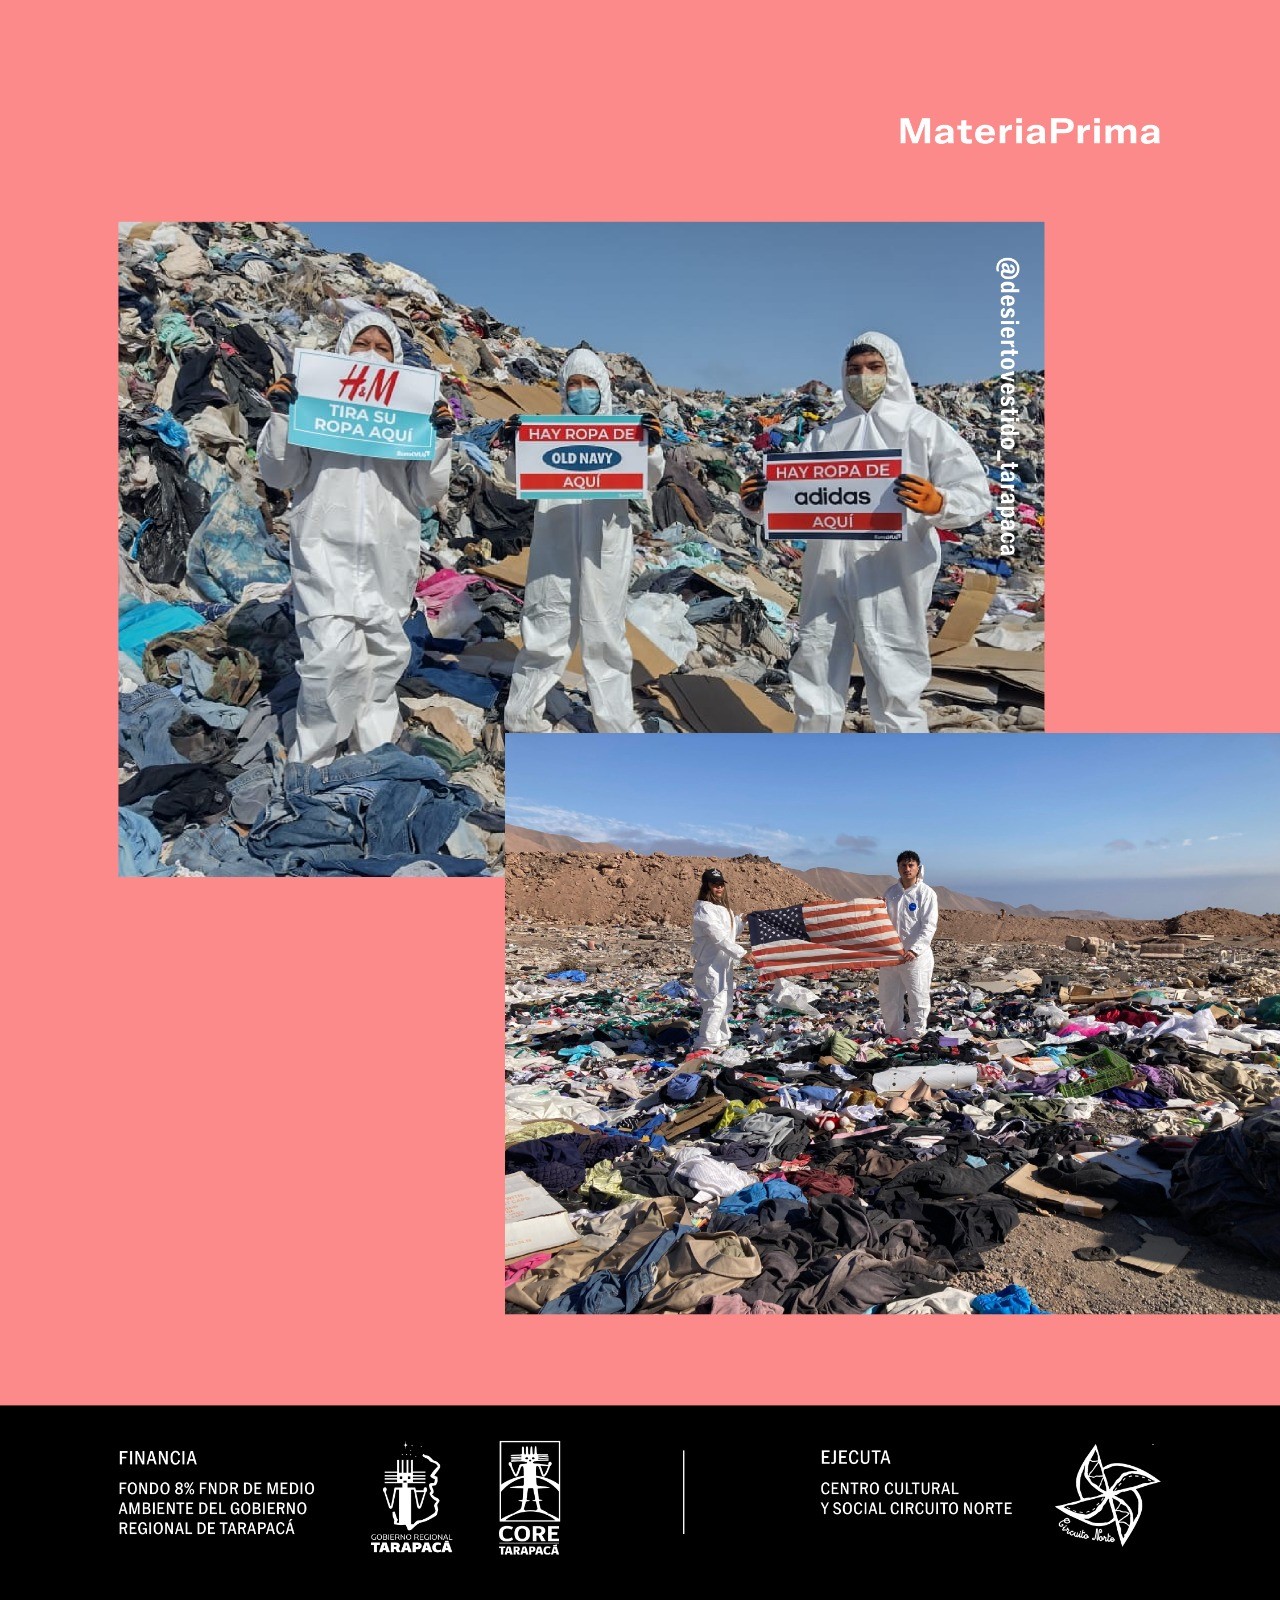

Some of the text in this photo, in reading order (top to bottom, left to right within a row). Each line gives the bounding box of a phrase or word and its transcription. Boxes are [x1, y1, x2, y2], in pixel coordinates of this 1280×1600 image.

[338, 364, 399, 407] H&M
[329, 404, 396, 425] TIRA SU
[314, 418, 413, 443] ROPA AQUÍ
[529, 428, 634, 440] HAY ROPA DE
[551, 452, 613, 464] OLD NAVY
[776, 463, 890, 479] HAY ROPA DE
[562, 474, 600, 489] AQUÍ
[794, 487, 871, 505] adidas
[812, 513, 853, 530] AQUÍ
